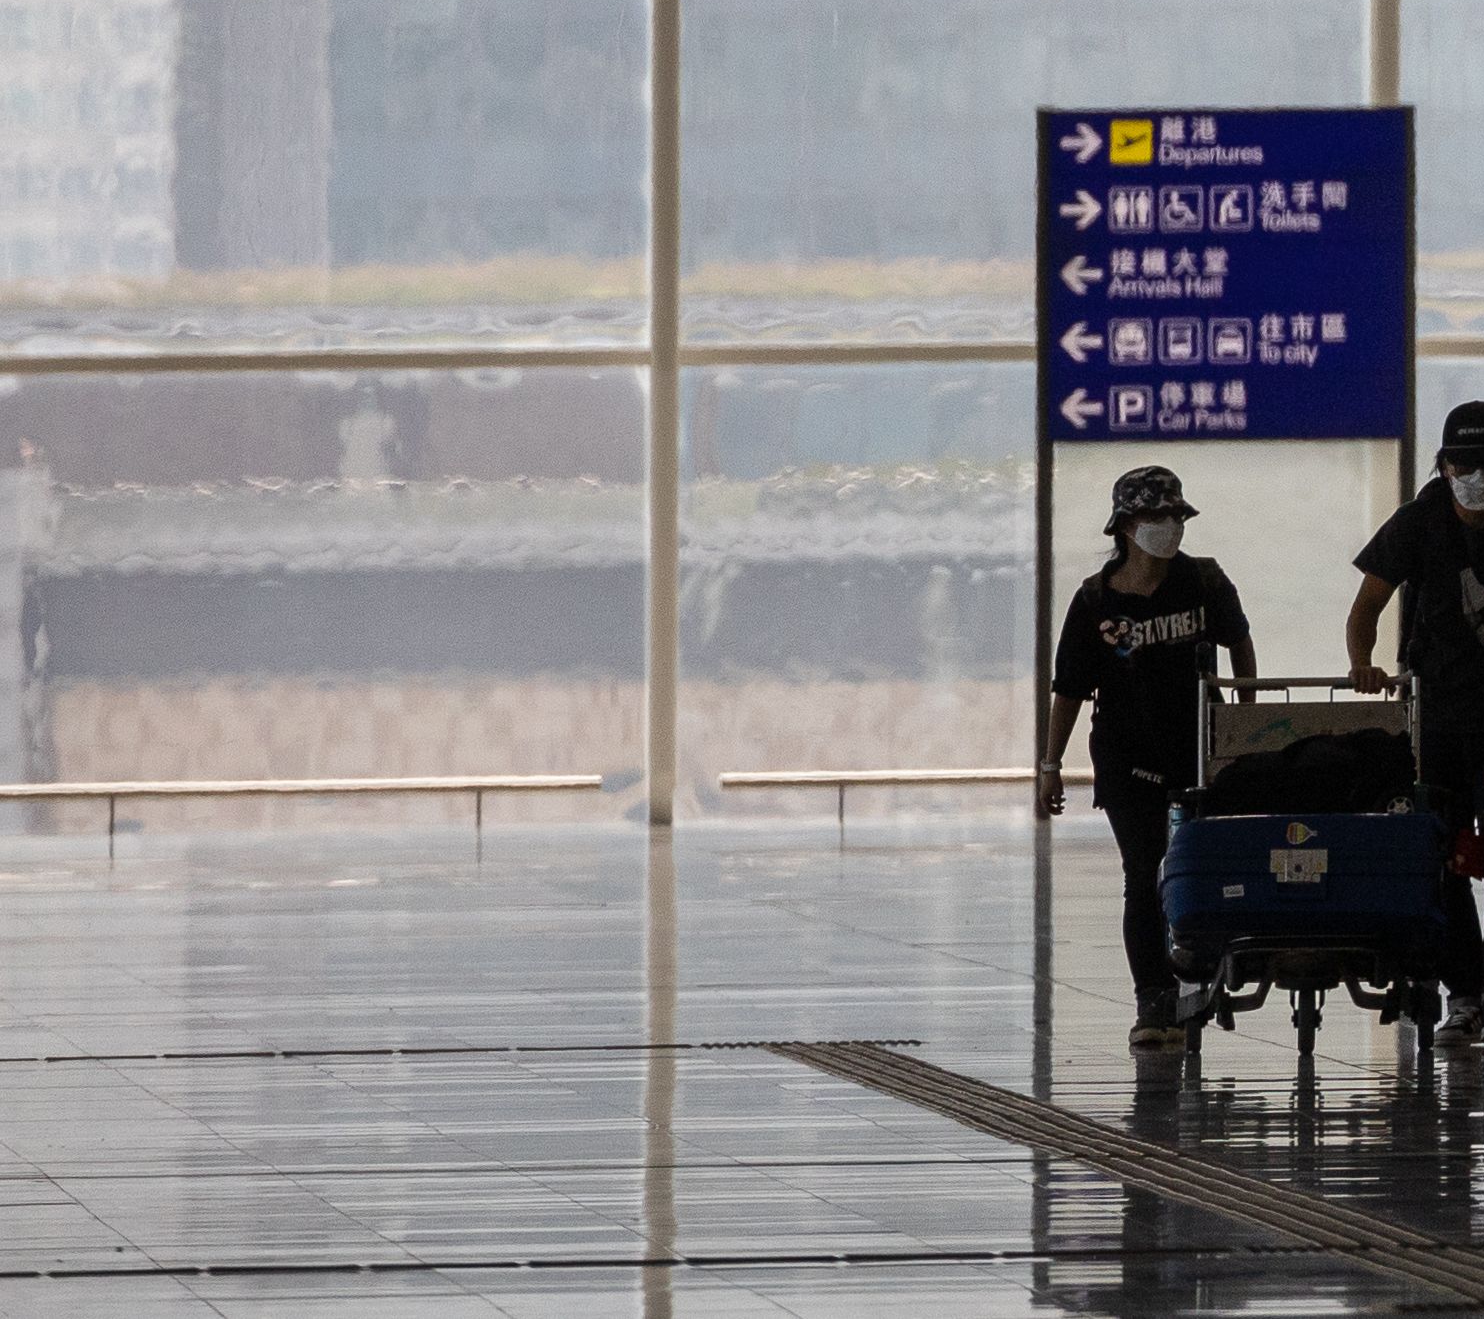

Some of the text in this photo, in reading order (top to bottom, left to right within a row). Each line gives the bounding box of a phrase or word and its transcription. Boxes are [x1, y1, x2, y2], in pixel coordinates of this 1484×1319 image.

[1158, 145, 1263, 167] Departures
[1259, 181, 1348, 210] 洗手間
[1260, 208, 1320, 231] Toilets
[1110, 248, 1228, 275] 接機大堂
[1109, 277, 1223, 298] Arrivals Hall
[1259, 341, 1318, 366] To city
[1160, 381, 1247, 409] 停車場
[1119, 392, 1146, 424] P
[1158, 408, 1247, 430] Car Parks
